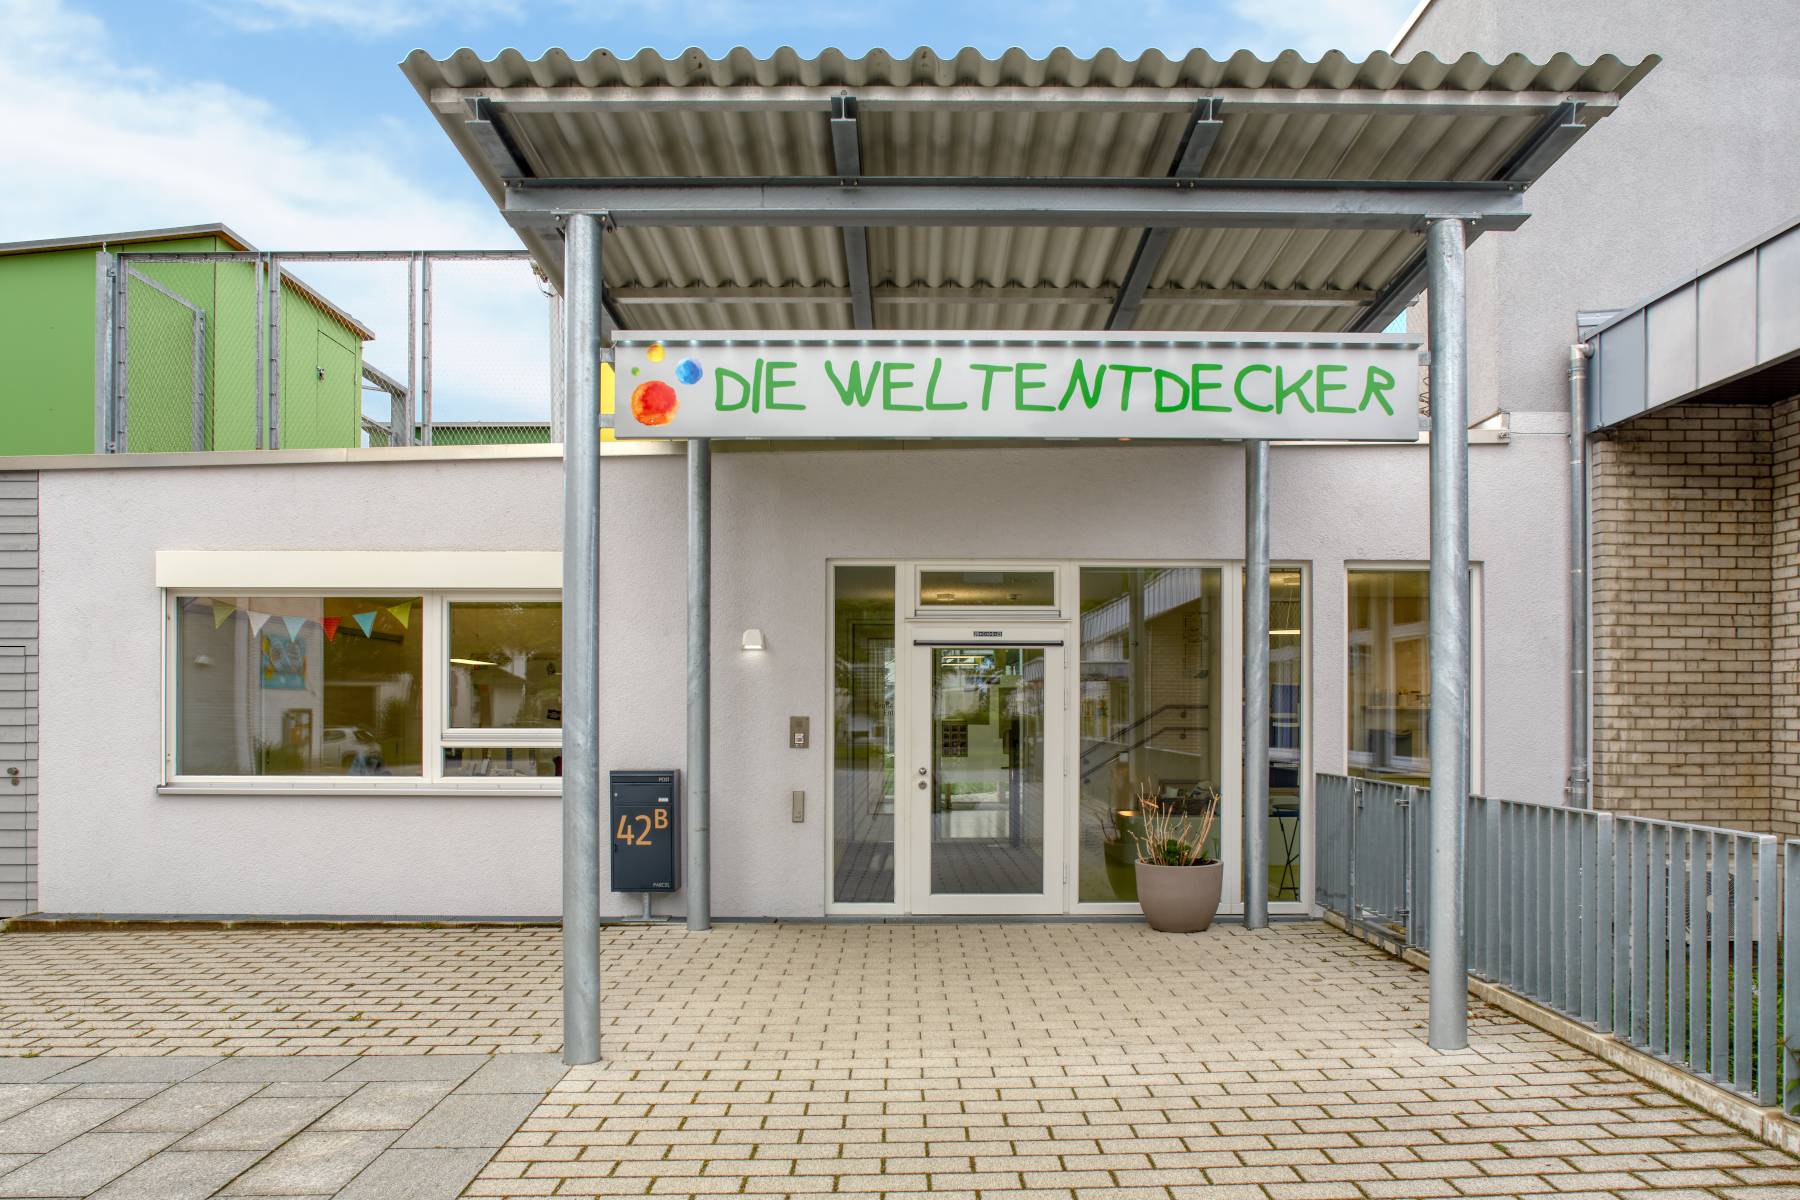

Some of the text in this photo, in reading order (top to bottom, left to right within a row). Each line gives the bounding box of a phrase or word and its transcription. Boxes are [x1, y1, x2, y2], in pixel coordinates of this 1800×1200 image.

[714, 356, 1397, 417] DIE WELTENTDECKER
[616, 808, 669, 846] 42B
